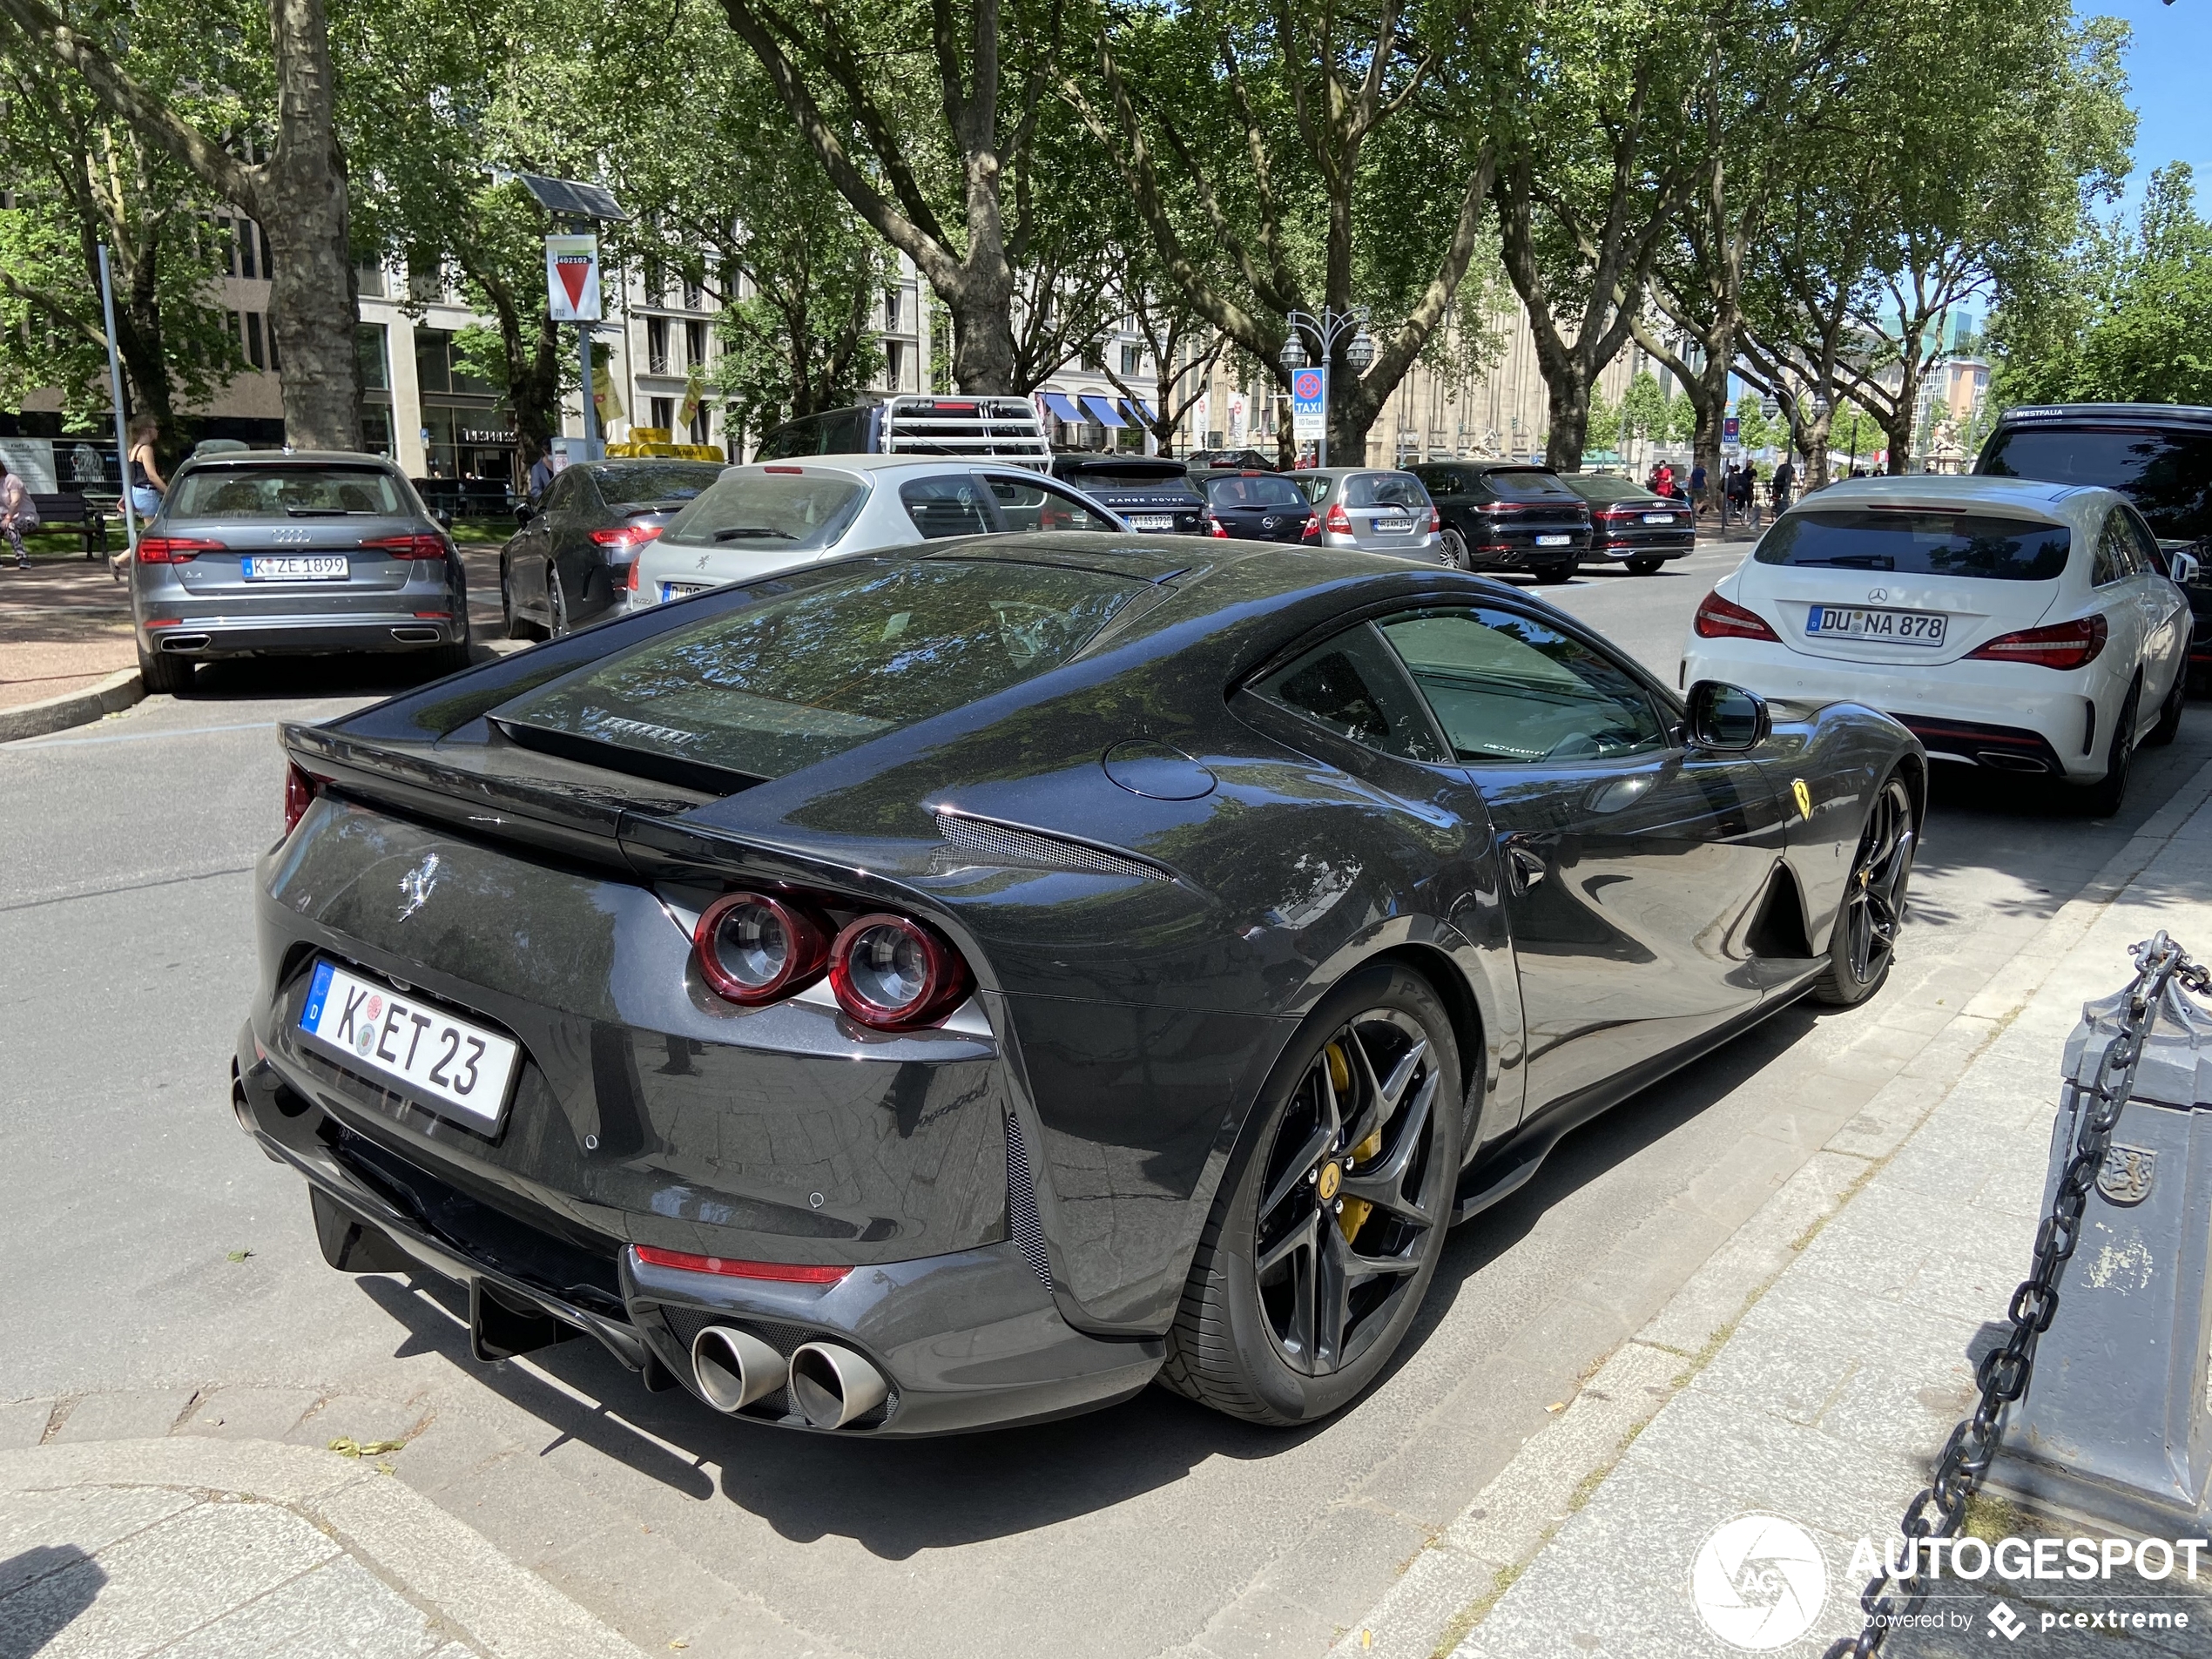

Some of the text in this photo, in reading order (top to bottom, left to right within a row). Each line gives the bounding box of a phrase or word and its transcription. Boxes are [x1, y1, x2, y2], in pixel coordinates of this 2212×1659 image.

[1295, 402, 1322, 414] TAXI
[1143, 516, 1153, 526] AS
[1154, 516, 1172, 526] 1720
[254, 559, 265, 574] K
[278, 558, 300, 573] ZE
[303, 557, 344, 573] 1899
[1822, 610, 1851, 631] DU
[1864, 614, 1892, 634] NA
[1899, 617, 1943, 637] 878
[309, 985, 487, 1096] D K ET 23
